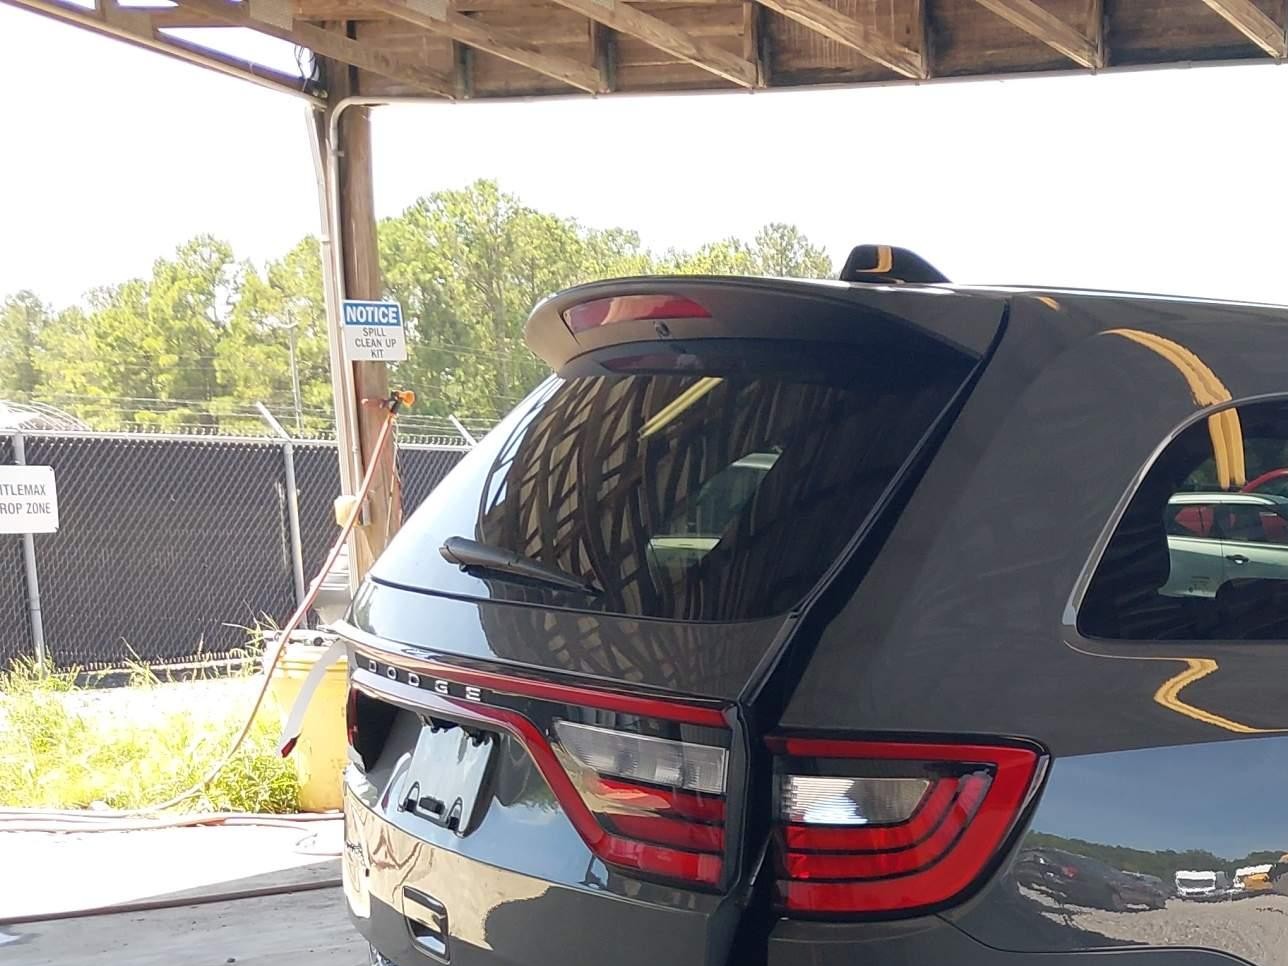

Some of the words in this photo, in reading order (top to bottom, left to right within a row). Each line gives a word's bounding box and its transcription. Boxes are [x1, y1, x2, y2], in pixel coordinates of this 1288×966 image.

[346, 305, 398, 324] NOTICE
[362, 327, 386, 337] SPILL
[354, 338, 383, 348] CLEAN
[385, 338, 397, 348] UP
[370, 349, 384, 359] KIT
[0, 502, 22, 515] ROP
[26, 502, 52, 514] ZONE
[368, 660, 480, 702] DODGE
